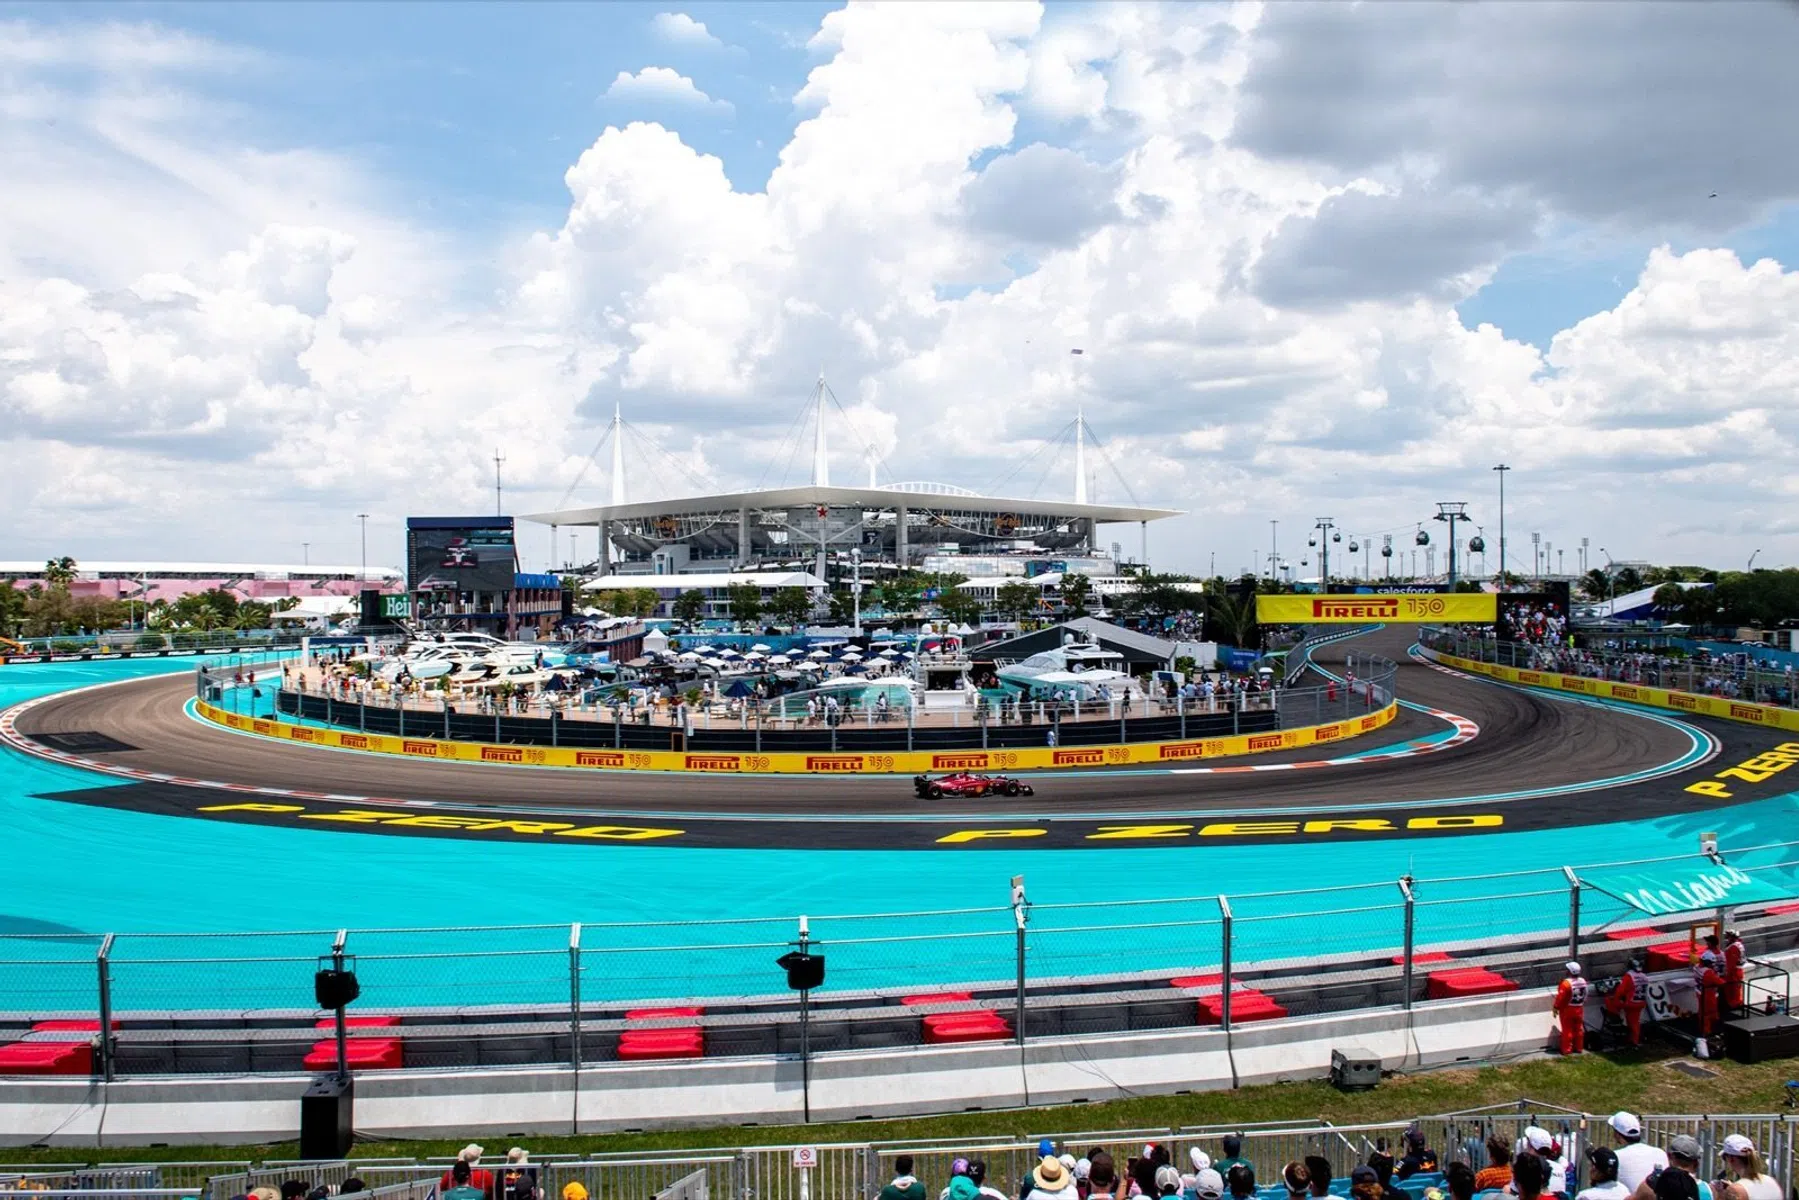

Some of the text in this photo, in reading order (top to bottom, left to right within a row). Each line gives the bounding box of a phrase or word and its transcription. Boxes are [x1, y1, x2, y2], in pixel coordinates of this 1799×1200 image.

[1377, 586, 1436, 595] salesforce
[1313, 598, 1445, 618] PIRELLI 150
[1668, 693, 1696, 710] PIRELLI
[1730, 704, 1764, 721] PIRELLI
[341, 734, 368, 749] PIRELLI
[403, 741, 438, 756] PIRELLI
[1248, 734, 1283, 750] PIRELLI
[481, 747, 523, 762] PIRELLI
[1053, 749, 1103, 765] PIRELLI
[1159, 743, 1203, 758] PIRELLI
[575, 751, 625, 767] PIRELLI
[685, 755, 770, 771] PIRELLI 150
[806, 755, 894, 770] PIRELLI 150
[932, 752, 1018, 769] PIRELLI 150
[1683, 781, 1734, 798] P
[197, 803, 686, 840] P ZERO
[936, 815, 1505, 843] P ZERO
